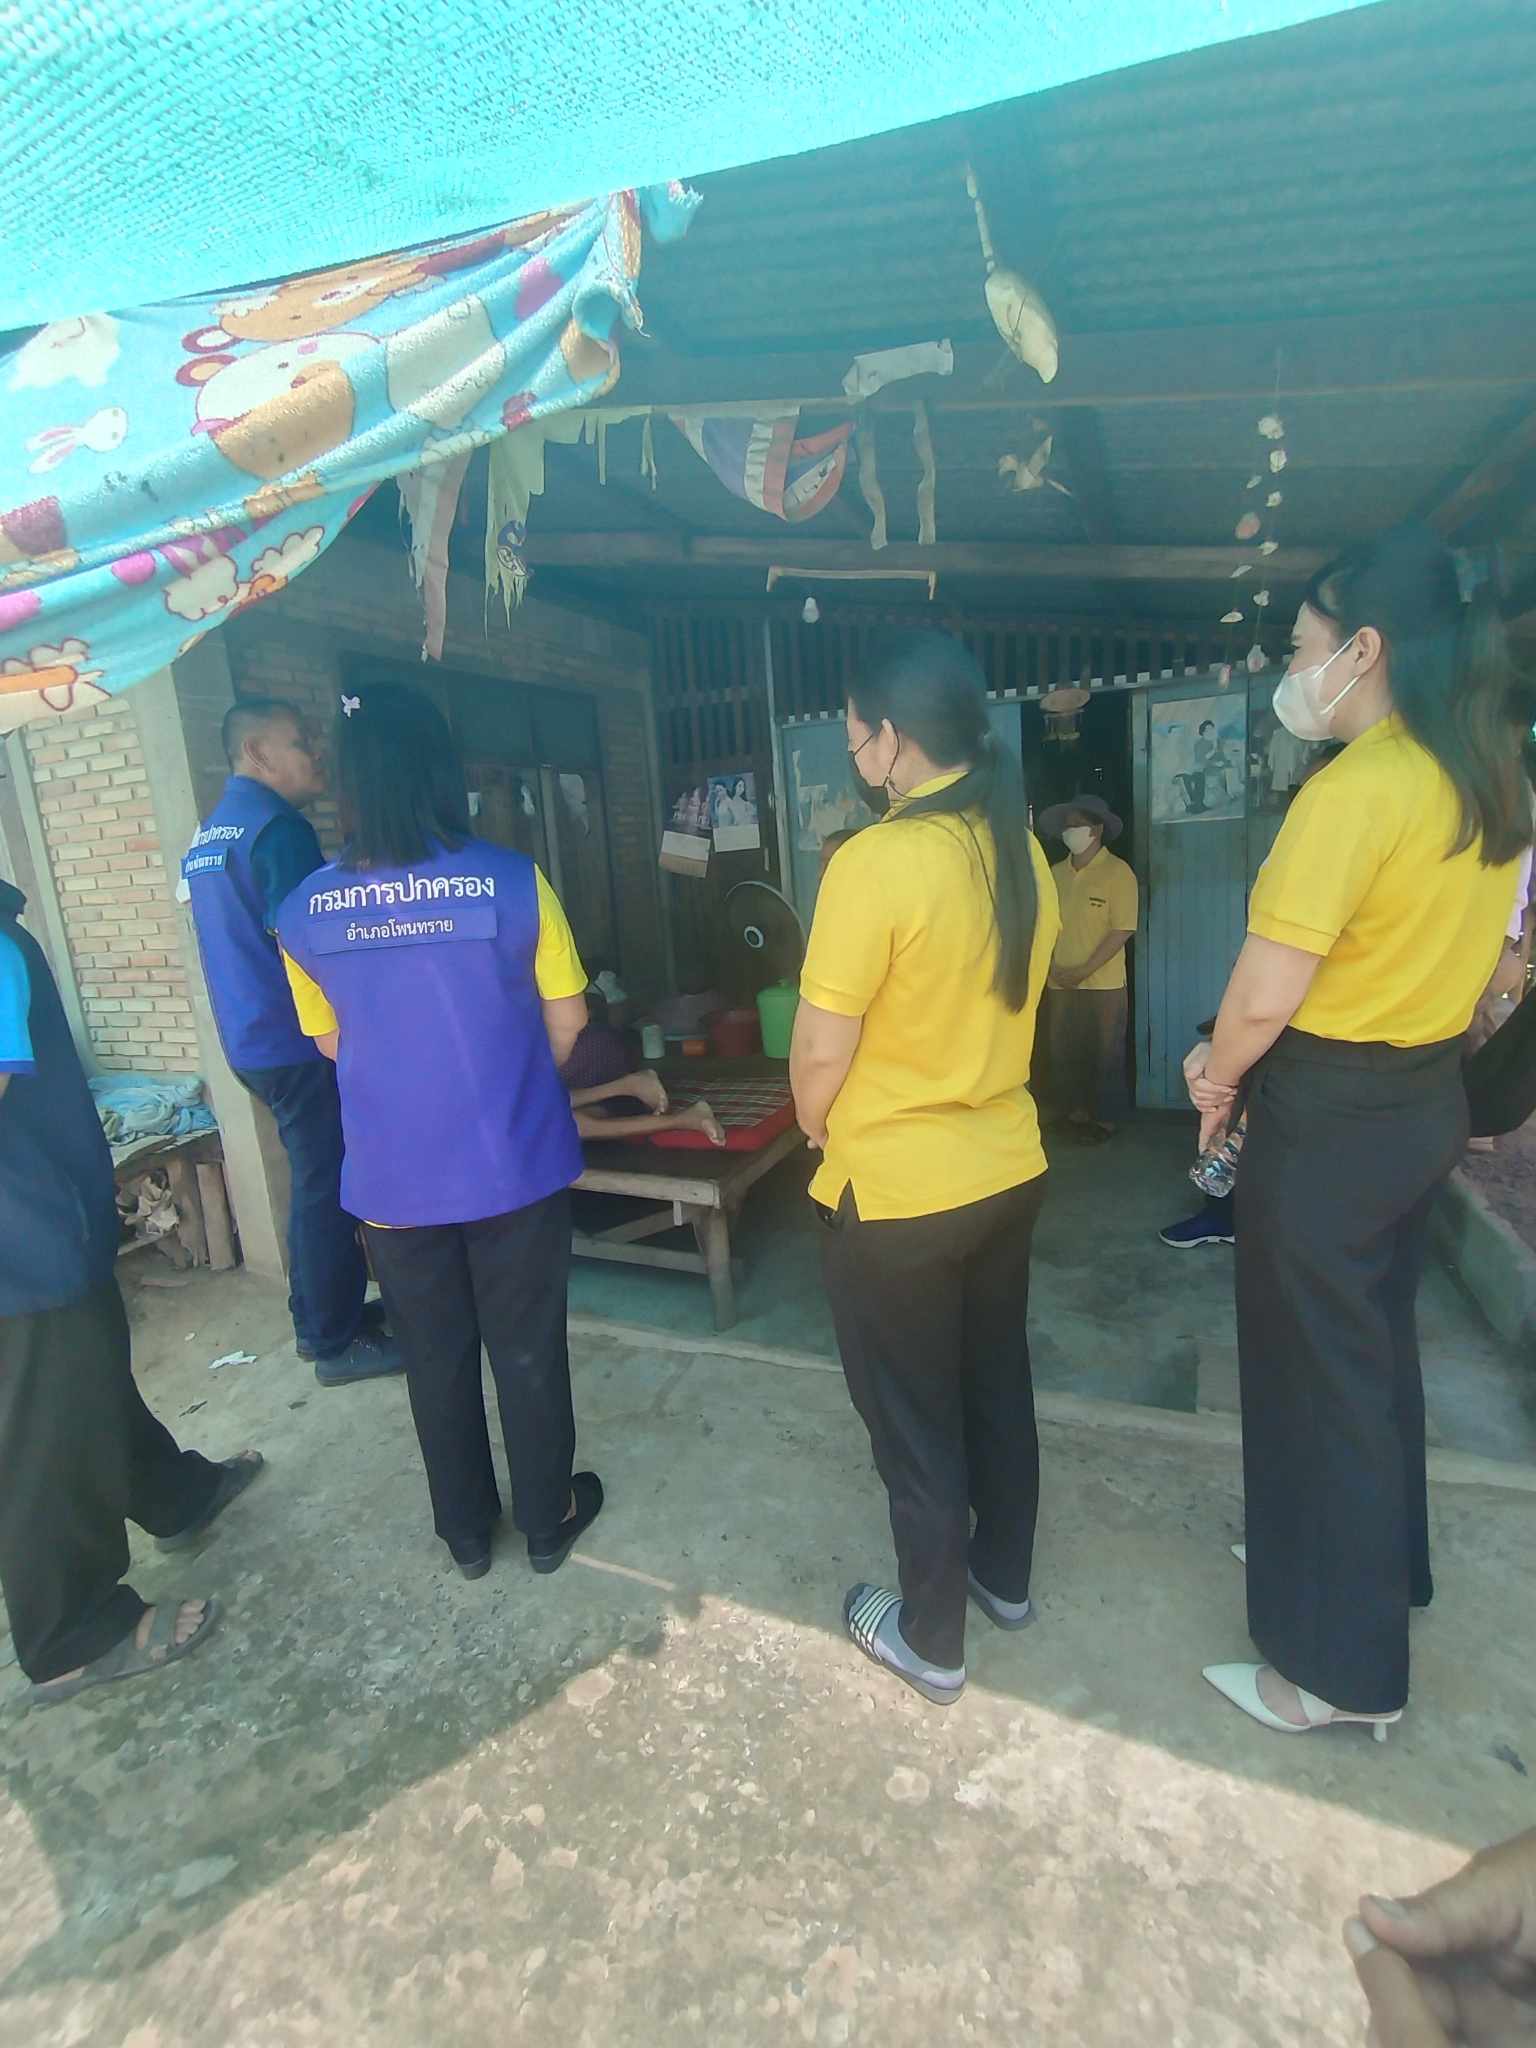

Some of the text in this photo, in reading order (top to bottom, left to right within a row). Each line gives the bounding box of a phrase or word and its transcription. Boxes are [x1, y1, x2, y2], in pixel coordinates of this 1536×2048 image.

[308, 873, 496, 915] กรมการปกครอง
[345, 918, 454, 941] อำเภอโพนทราย
